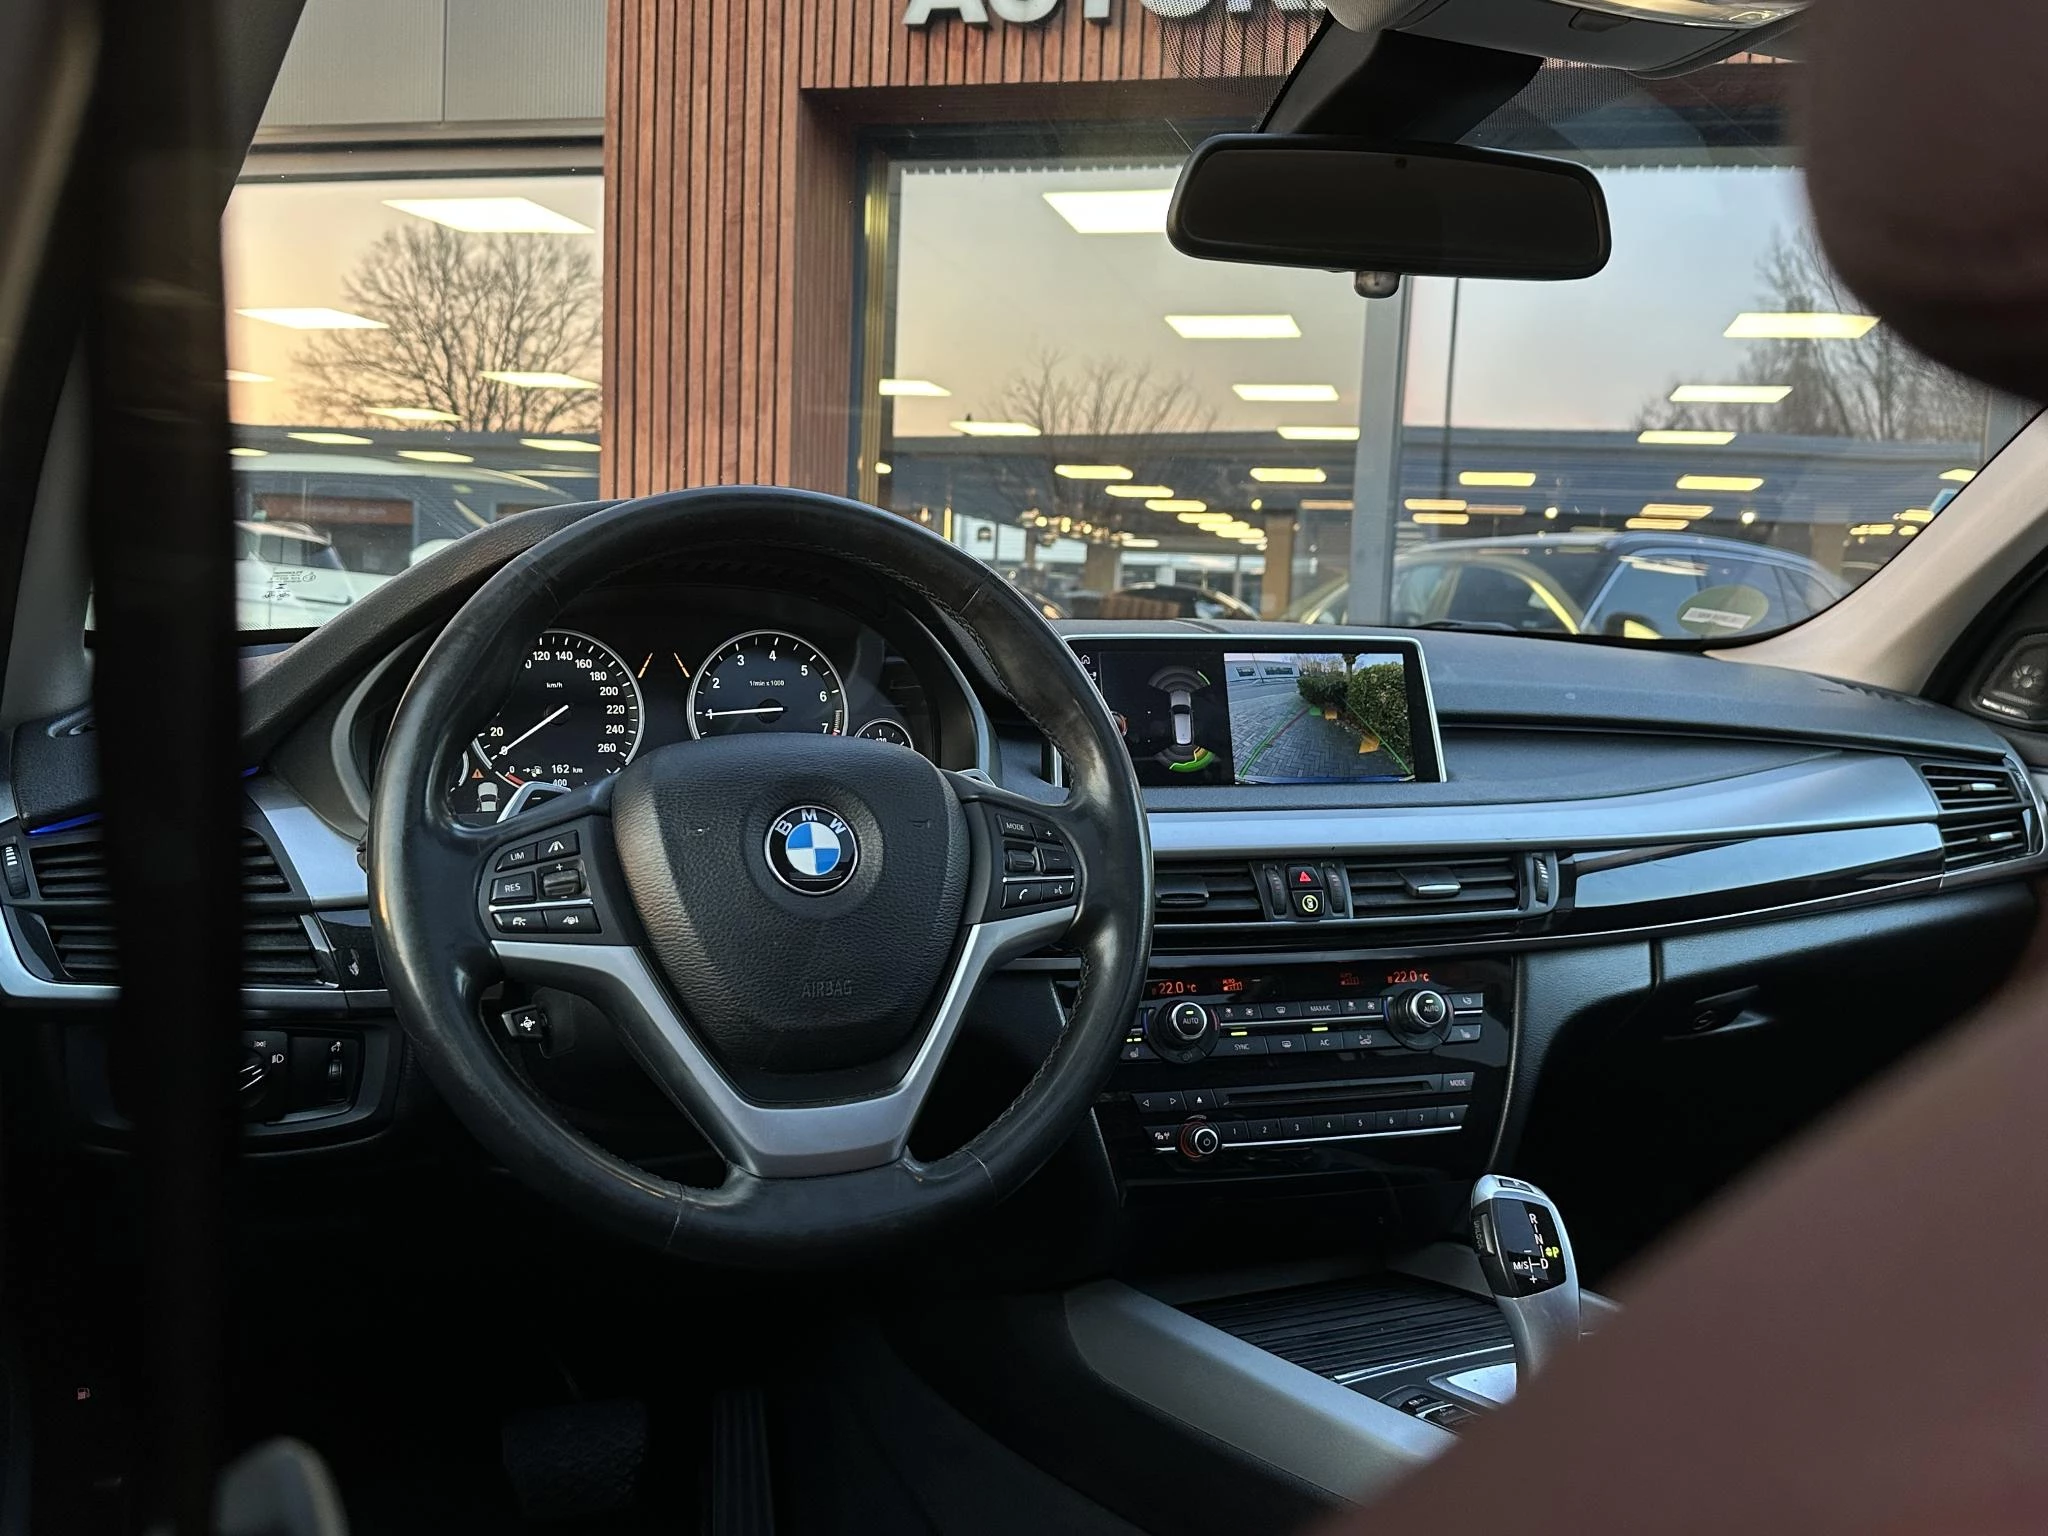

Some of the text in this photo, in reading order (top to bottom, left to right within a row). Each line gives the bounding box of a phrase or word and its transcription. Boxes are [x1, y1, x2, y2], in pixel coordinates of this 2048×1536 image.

[533, 651, 551, 661] 120
[555, 651, 574, 661] 140
[737, 655, 745, 666] 3
[769, 650, 777, 661] 4
[574, 659, 593, 669] 160
[801, 665, 809, 676] 5
[589, 671, 607, 681] 180
[712, 678, 720, 689] 2
[600, 686, 619, 696] 200
[820, 691, 828, 702] 6
[606, 705, 625, 714] 220
[490, 727, 504, 737] 20
[605, 725, 625, 734] 240
[821, 723, 829, 734] 7
[597, 743, 617, 753] 260
[551, 765, 570, 774] 162
[775, 808, 847, 837] BMW
[1006, 822, 1025, 832] MODE
[510, 852, 525, 861] LIM
[504, 883, 521, 893] RES
[801, 979, 852, 999] AIRBAG
[1424, 1004, 1440, 1013] AUTO
[1182, 1017, 1199, 1025] AUTO
[1234, 1043, 1250, 1051] SYNC
[1320, 1038, 1330, 1047] A/C
[1449, 1078, 1467, 1087] MODE
[1232, 1127, 1237, 1135] 1
[1262, 1125, 1268, 1134] 2
[1294, 1122, 1300, 1132] 3
[1326, 1119, 1332, 1129] 4
[1357, 1117, 1363, 1127] 5
[1389, 1115, 1395, 1125] 6
[1528, 1213, 1539, 1224] R
[1534, 1233, 1544, 1245] N
[1552, 1247, 1560, 1258] P
[1512, 1258, 1549, 1270] M/S D
